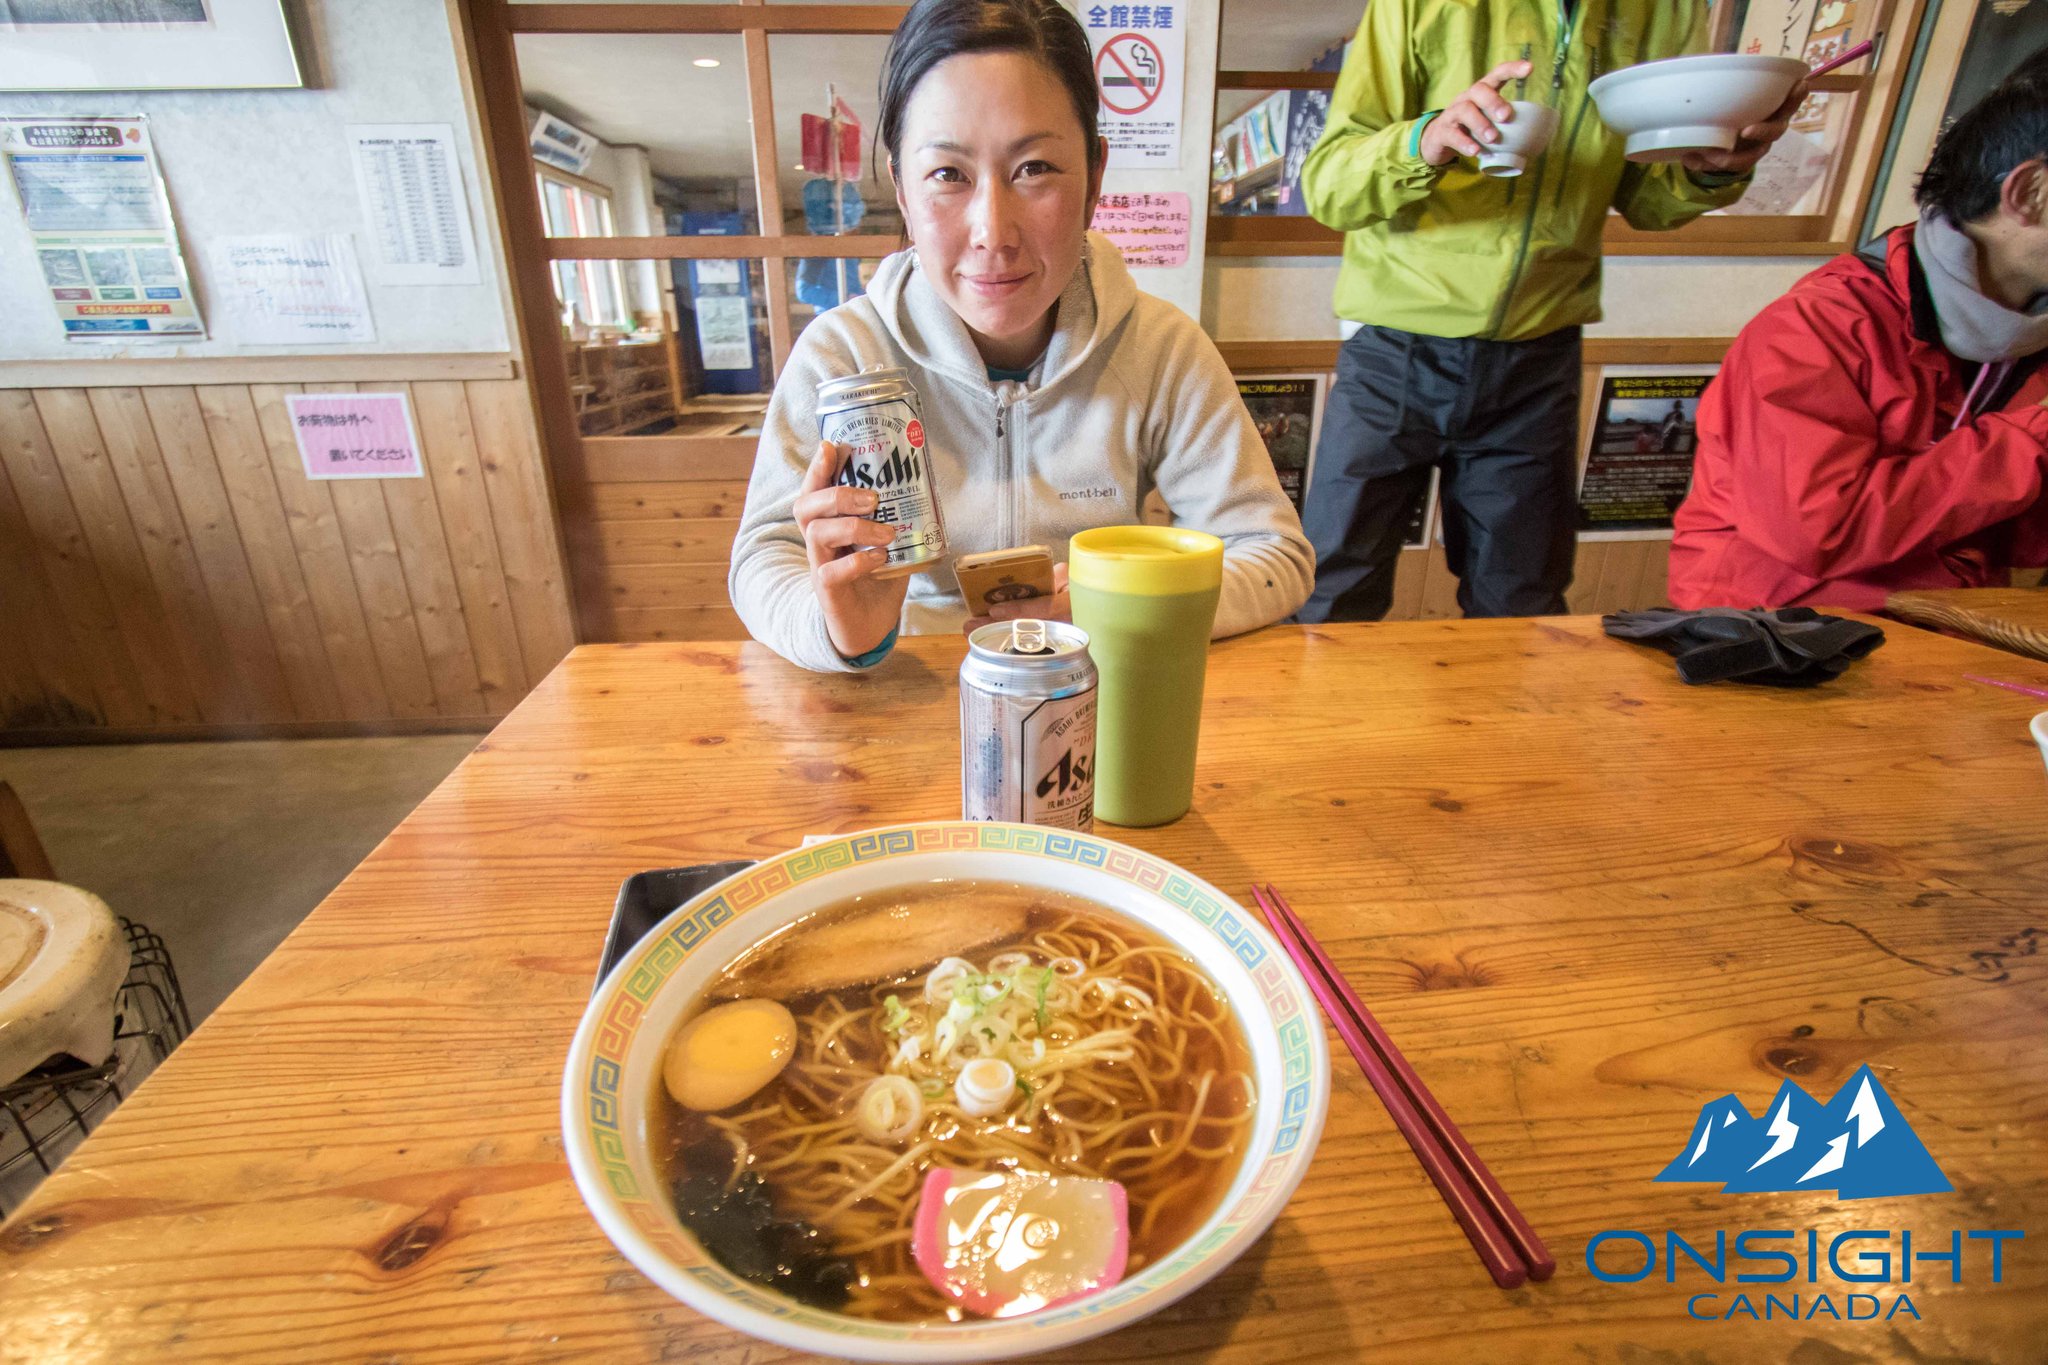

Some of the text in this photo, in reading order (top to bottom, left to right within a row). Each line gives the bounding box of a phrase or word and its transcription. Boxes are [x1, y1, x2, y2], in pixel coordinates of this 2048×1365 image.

[1088, 5, 1173, 28] 全館禁煙
[881, 418, 903, 434] LIMITED
[838, 446, 922, 489] Asahi
[874, 506, 898, 523] 生
[1055, 717, 1074, 738] ASAHI
